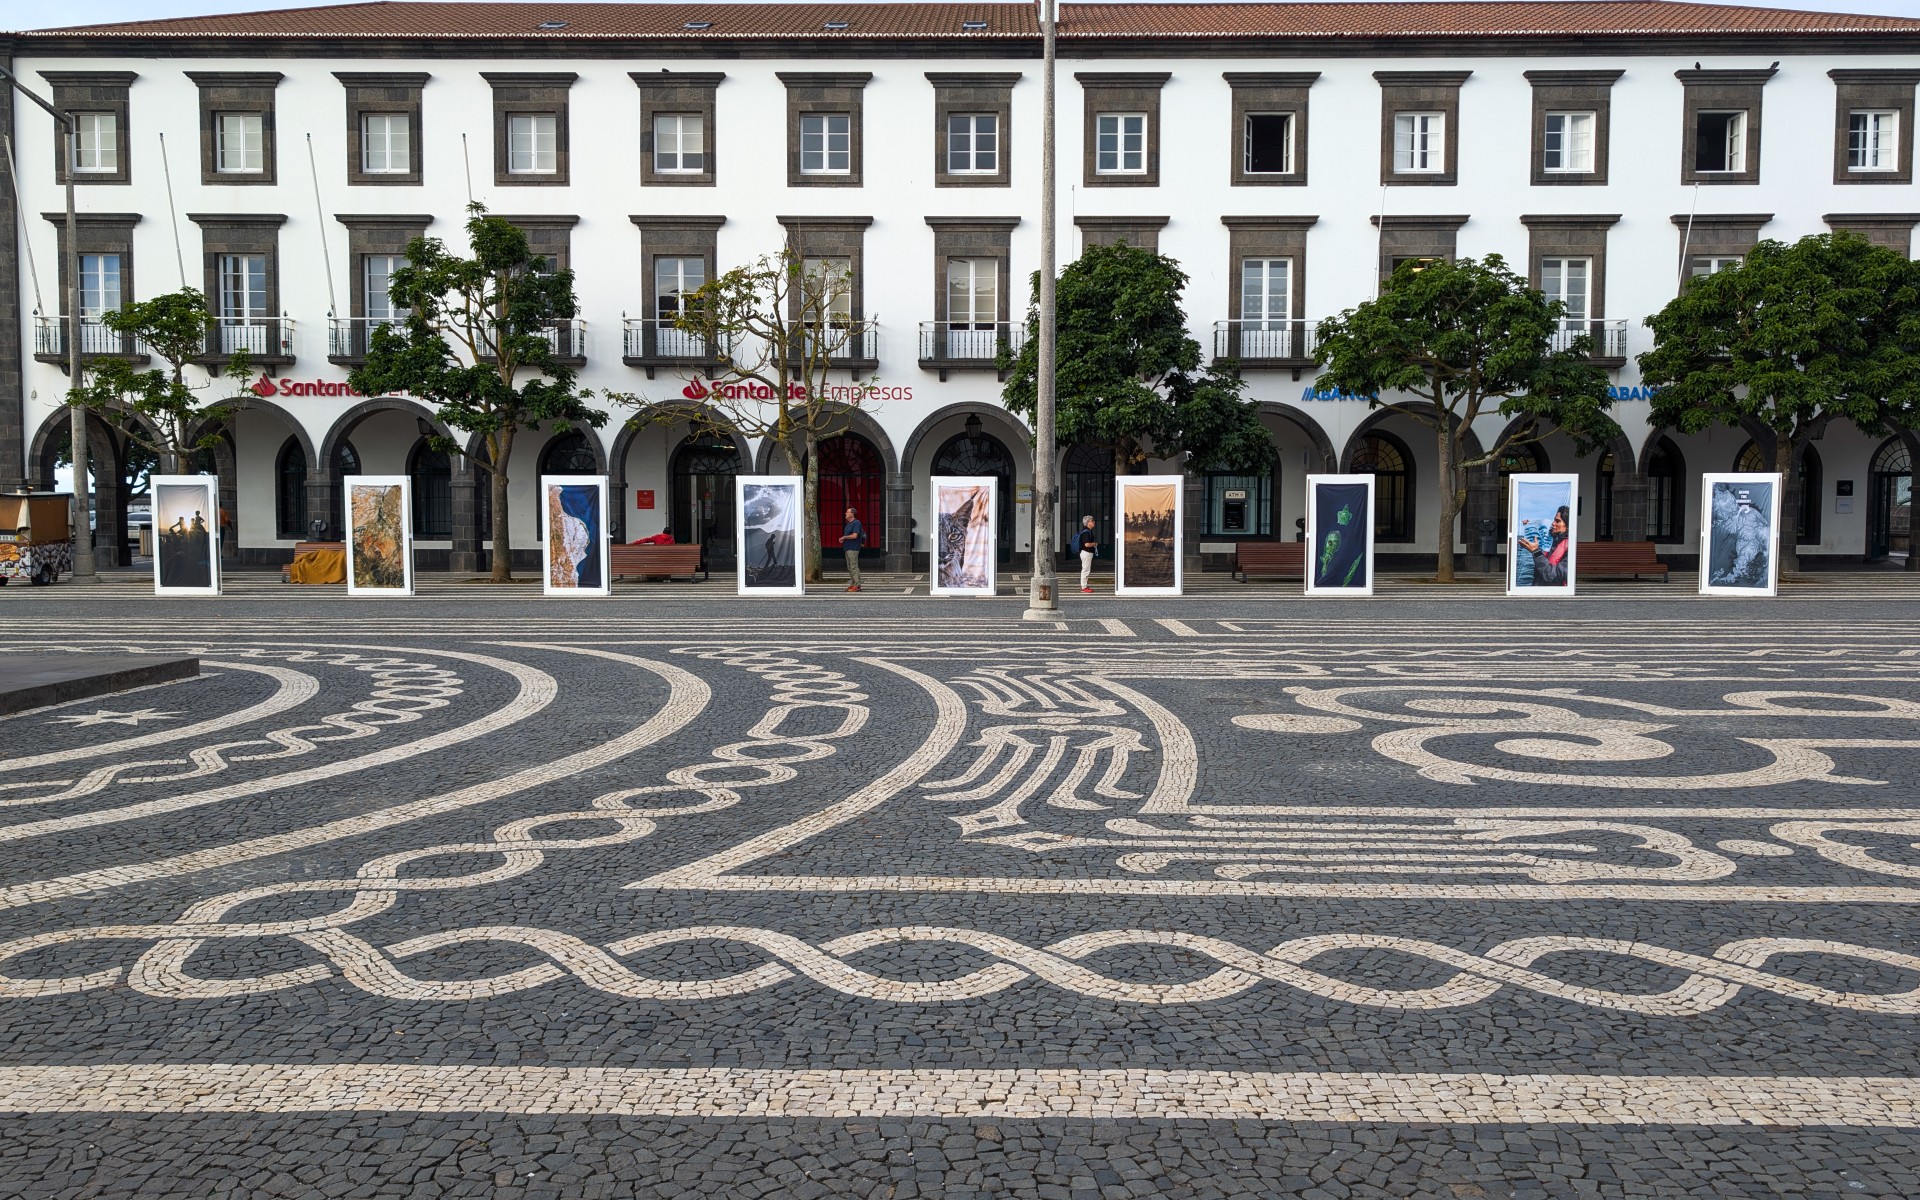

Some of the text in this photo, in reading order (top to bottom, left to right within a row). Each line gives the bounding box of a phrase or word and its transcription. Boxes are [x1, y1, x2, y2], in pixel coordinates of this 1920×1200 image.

[279, 378, 371, 397] Santan
[711, 381, 913, 404] Santade Empresas
[1608, 386, 1664, 401] ABAN
